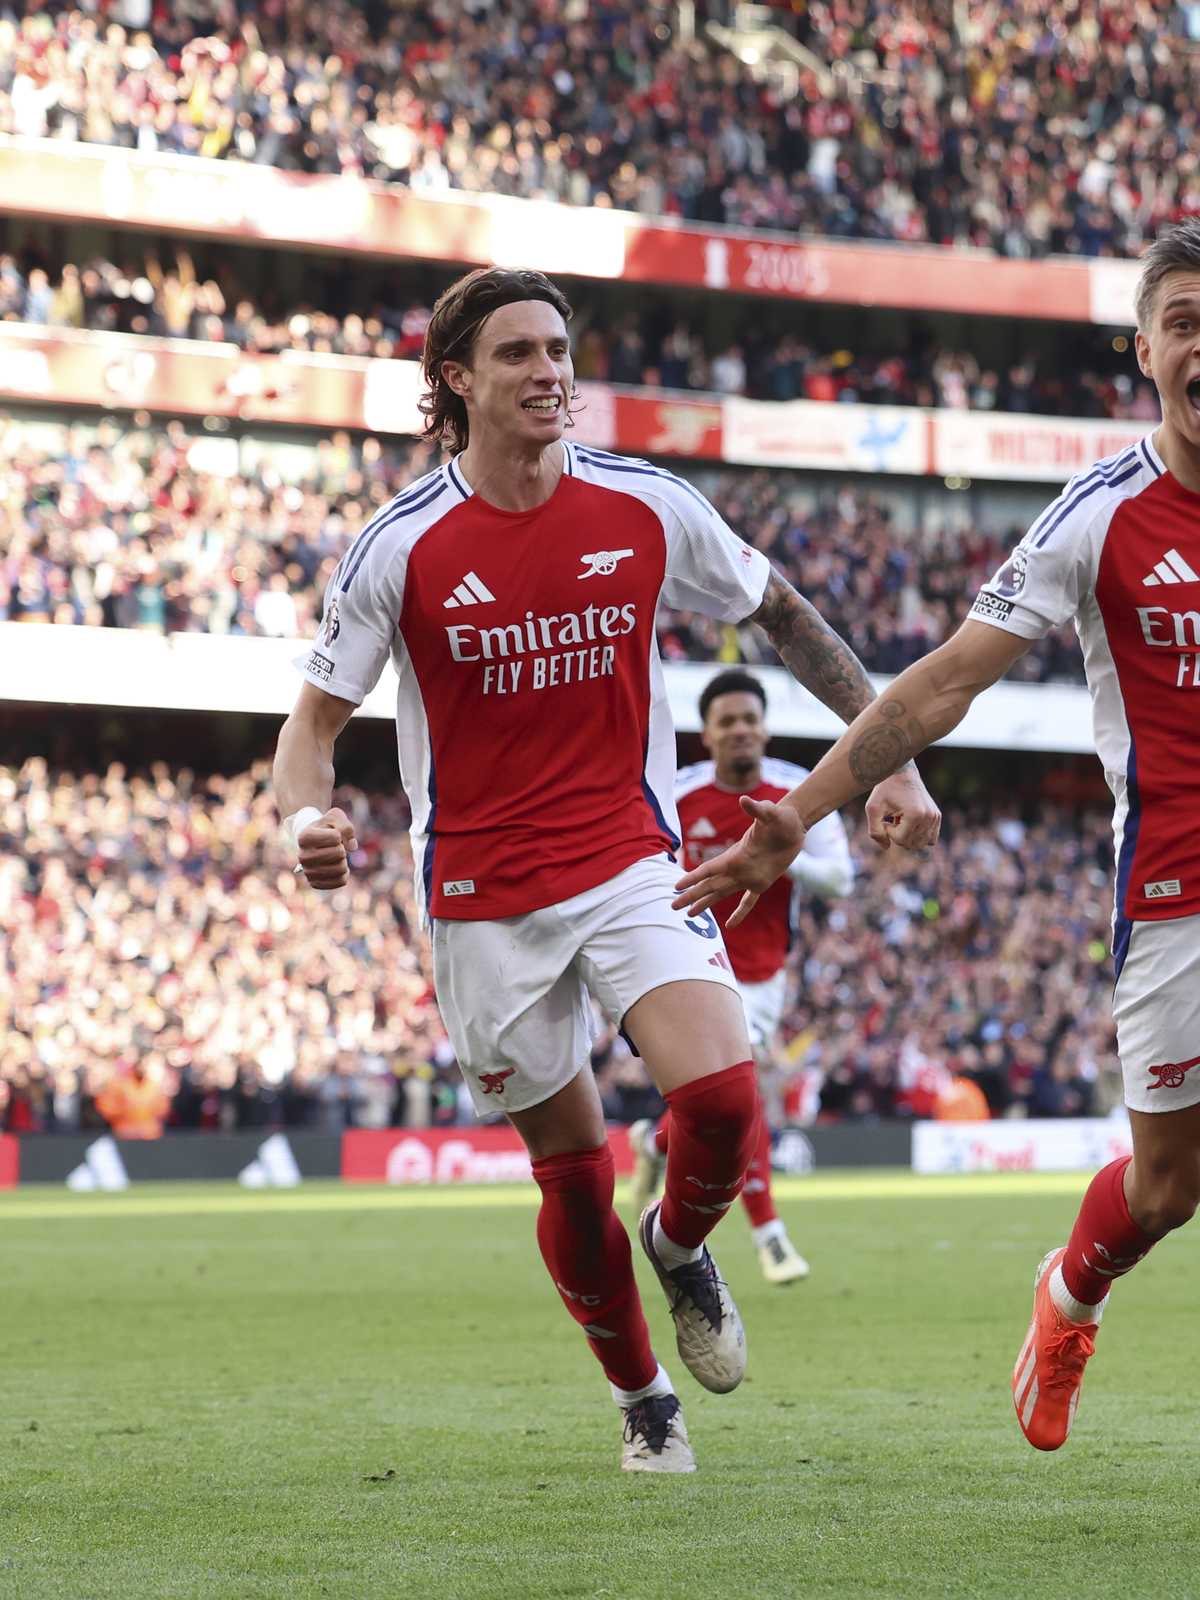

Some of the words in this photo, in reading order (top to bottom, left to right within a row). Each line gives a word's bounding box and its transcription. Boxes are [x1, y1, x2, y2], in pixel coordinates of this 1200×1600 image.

[744, 242, 830, 296] 2005
[444, 602, 637, 662] Emirates
[976, 603, 1009, 622] racism
[482, 661, 523, 695] FLY
[532, 645, 615, 690] BETTER
